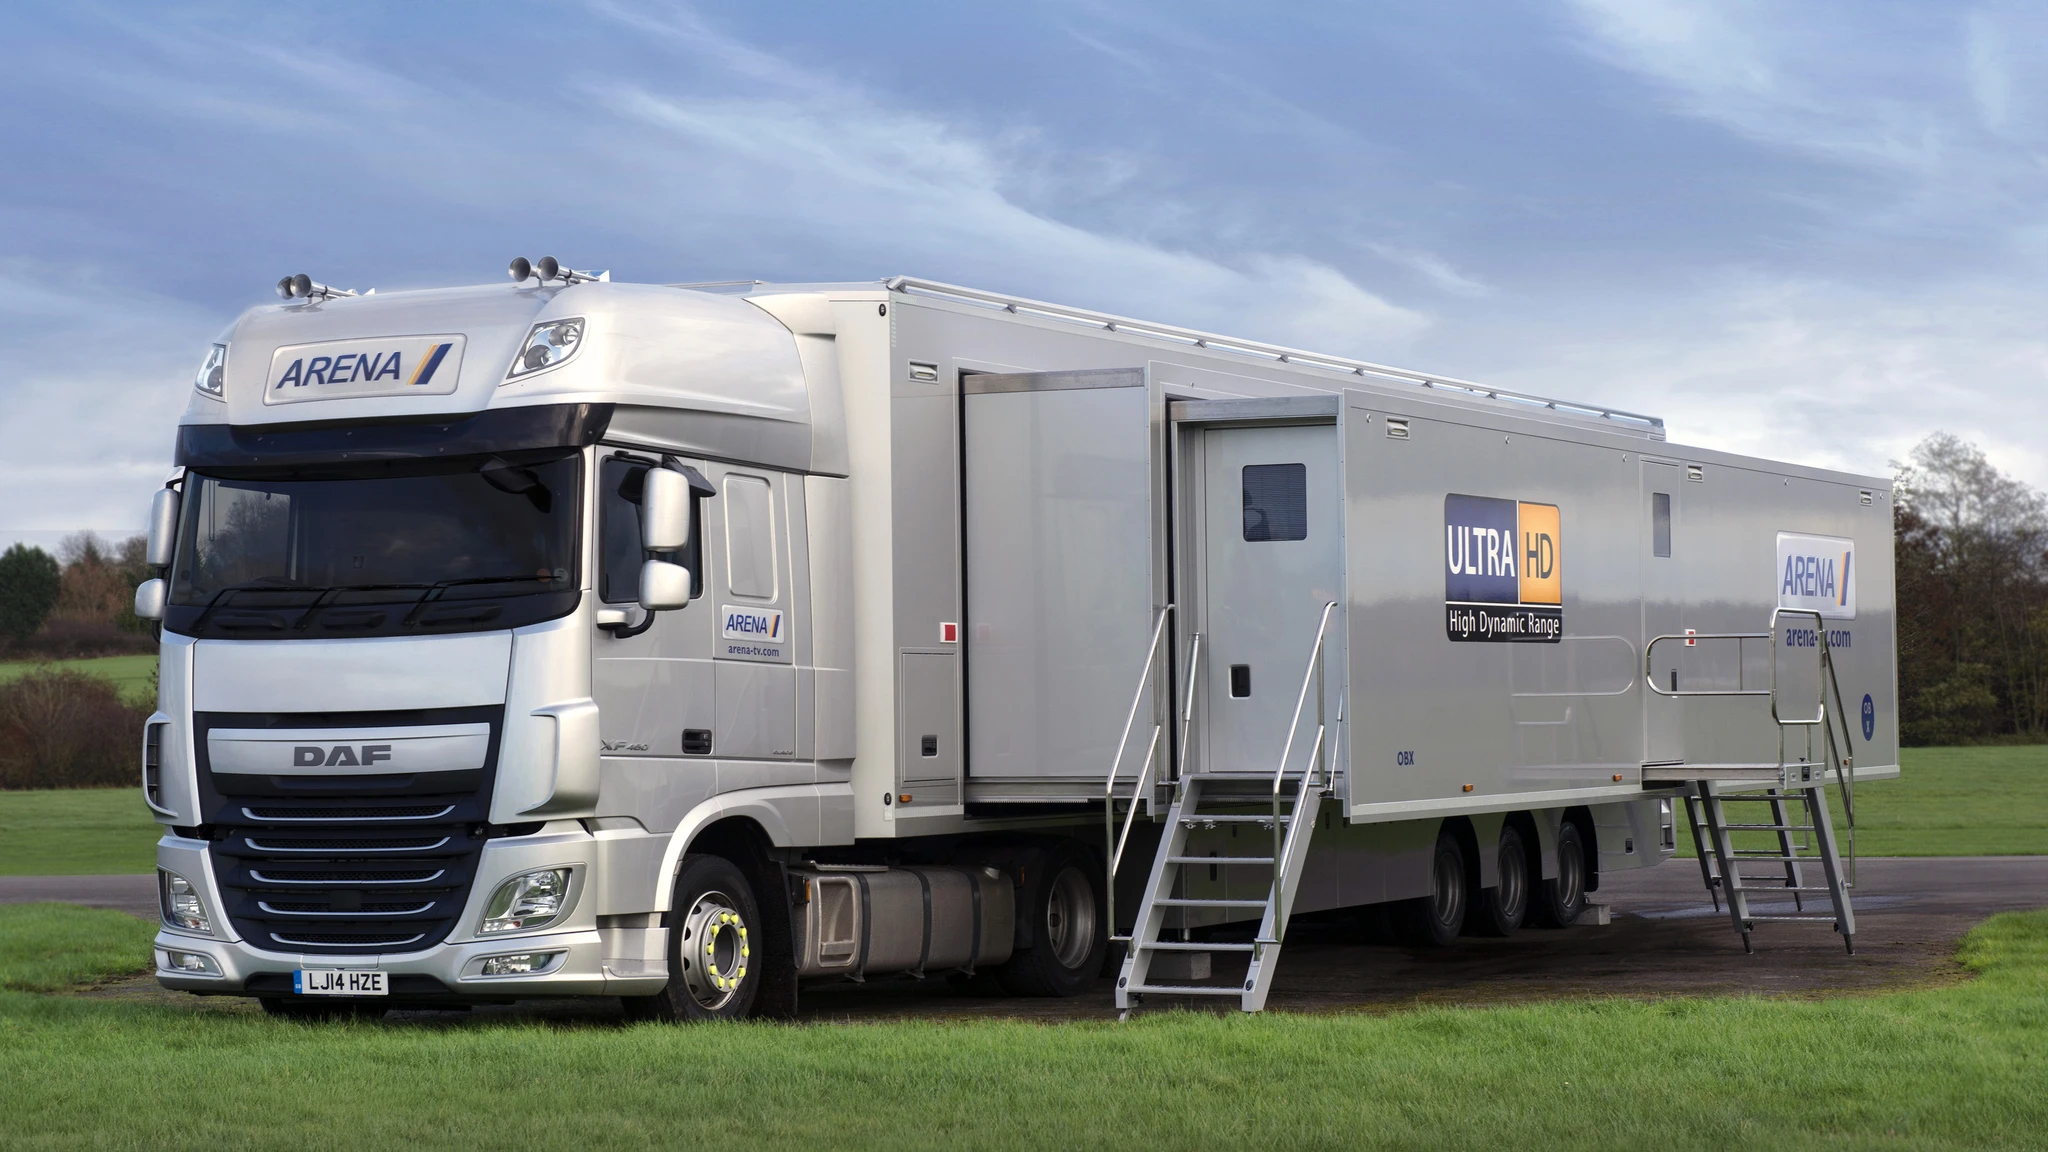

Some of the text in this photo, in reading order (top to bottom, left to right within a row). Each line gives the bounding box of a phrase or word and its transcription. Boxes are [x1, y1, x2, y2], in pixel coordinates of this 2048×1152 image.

[275, 351, 401, 389] ARENA
[1447, 525, 1516, 577] ULTRA
[1526, 532, 1554, 579] HD
[1782, 554, 1835, 598] ARENA
[726, 614, 768, 634] ARENA
[1449, 609, 1559, 639] High Dynamic Range
[1786, 628, 1851, 648] arena-.com
[728, 645, 780, 657] arena-tv.com
[600, 739, 627, 751] XF
[293, 745, 391, 766] DAF
[1397, 751, 1414, 766] OBX
[309, 973, 382, 991] LJ14 HZE
